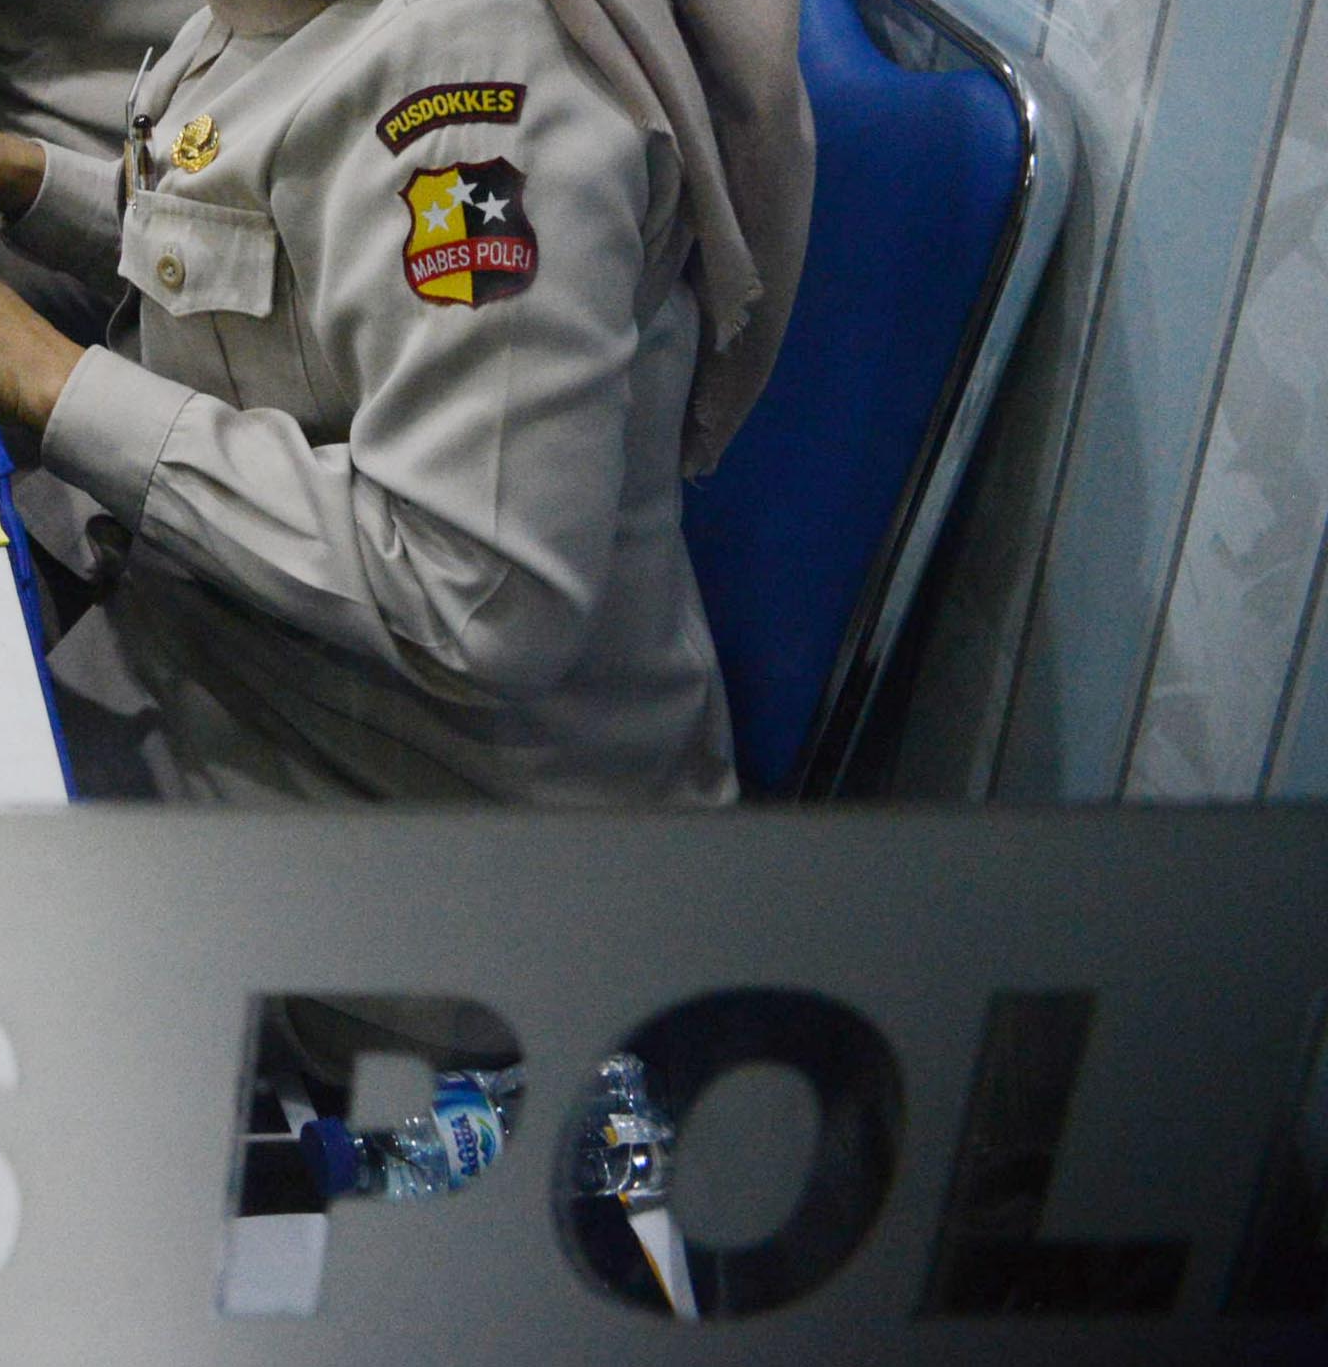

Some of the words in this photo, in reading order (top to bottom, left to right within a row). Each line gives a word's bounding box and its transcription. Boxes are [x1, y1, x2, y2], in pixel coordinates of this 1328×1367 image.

[385, 89, 516, 142] PUSDOKKES
[411, 245, 471, 283] MABES
[476, 240, 532, 270] POLRI
[448, 1112, 481, 1178] AQUA
